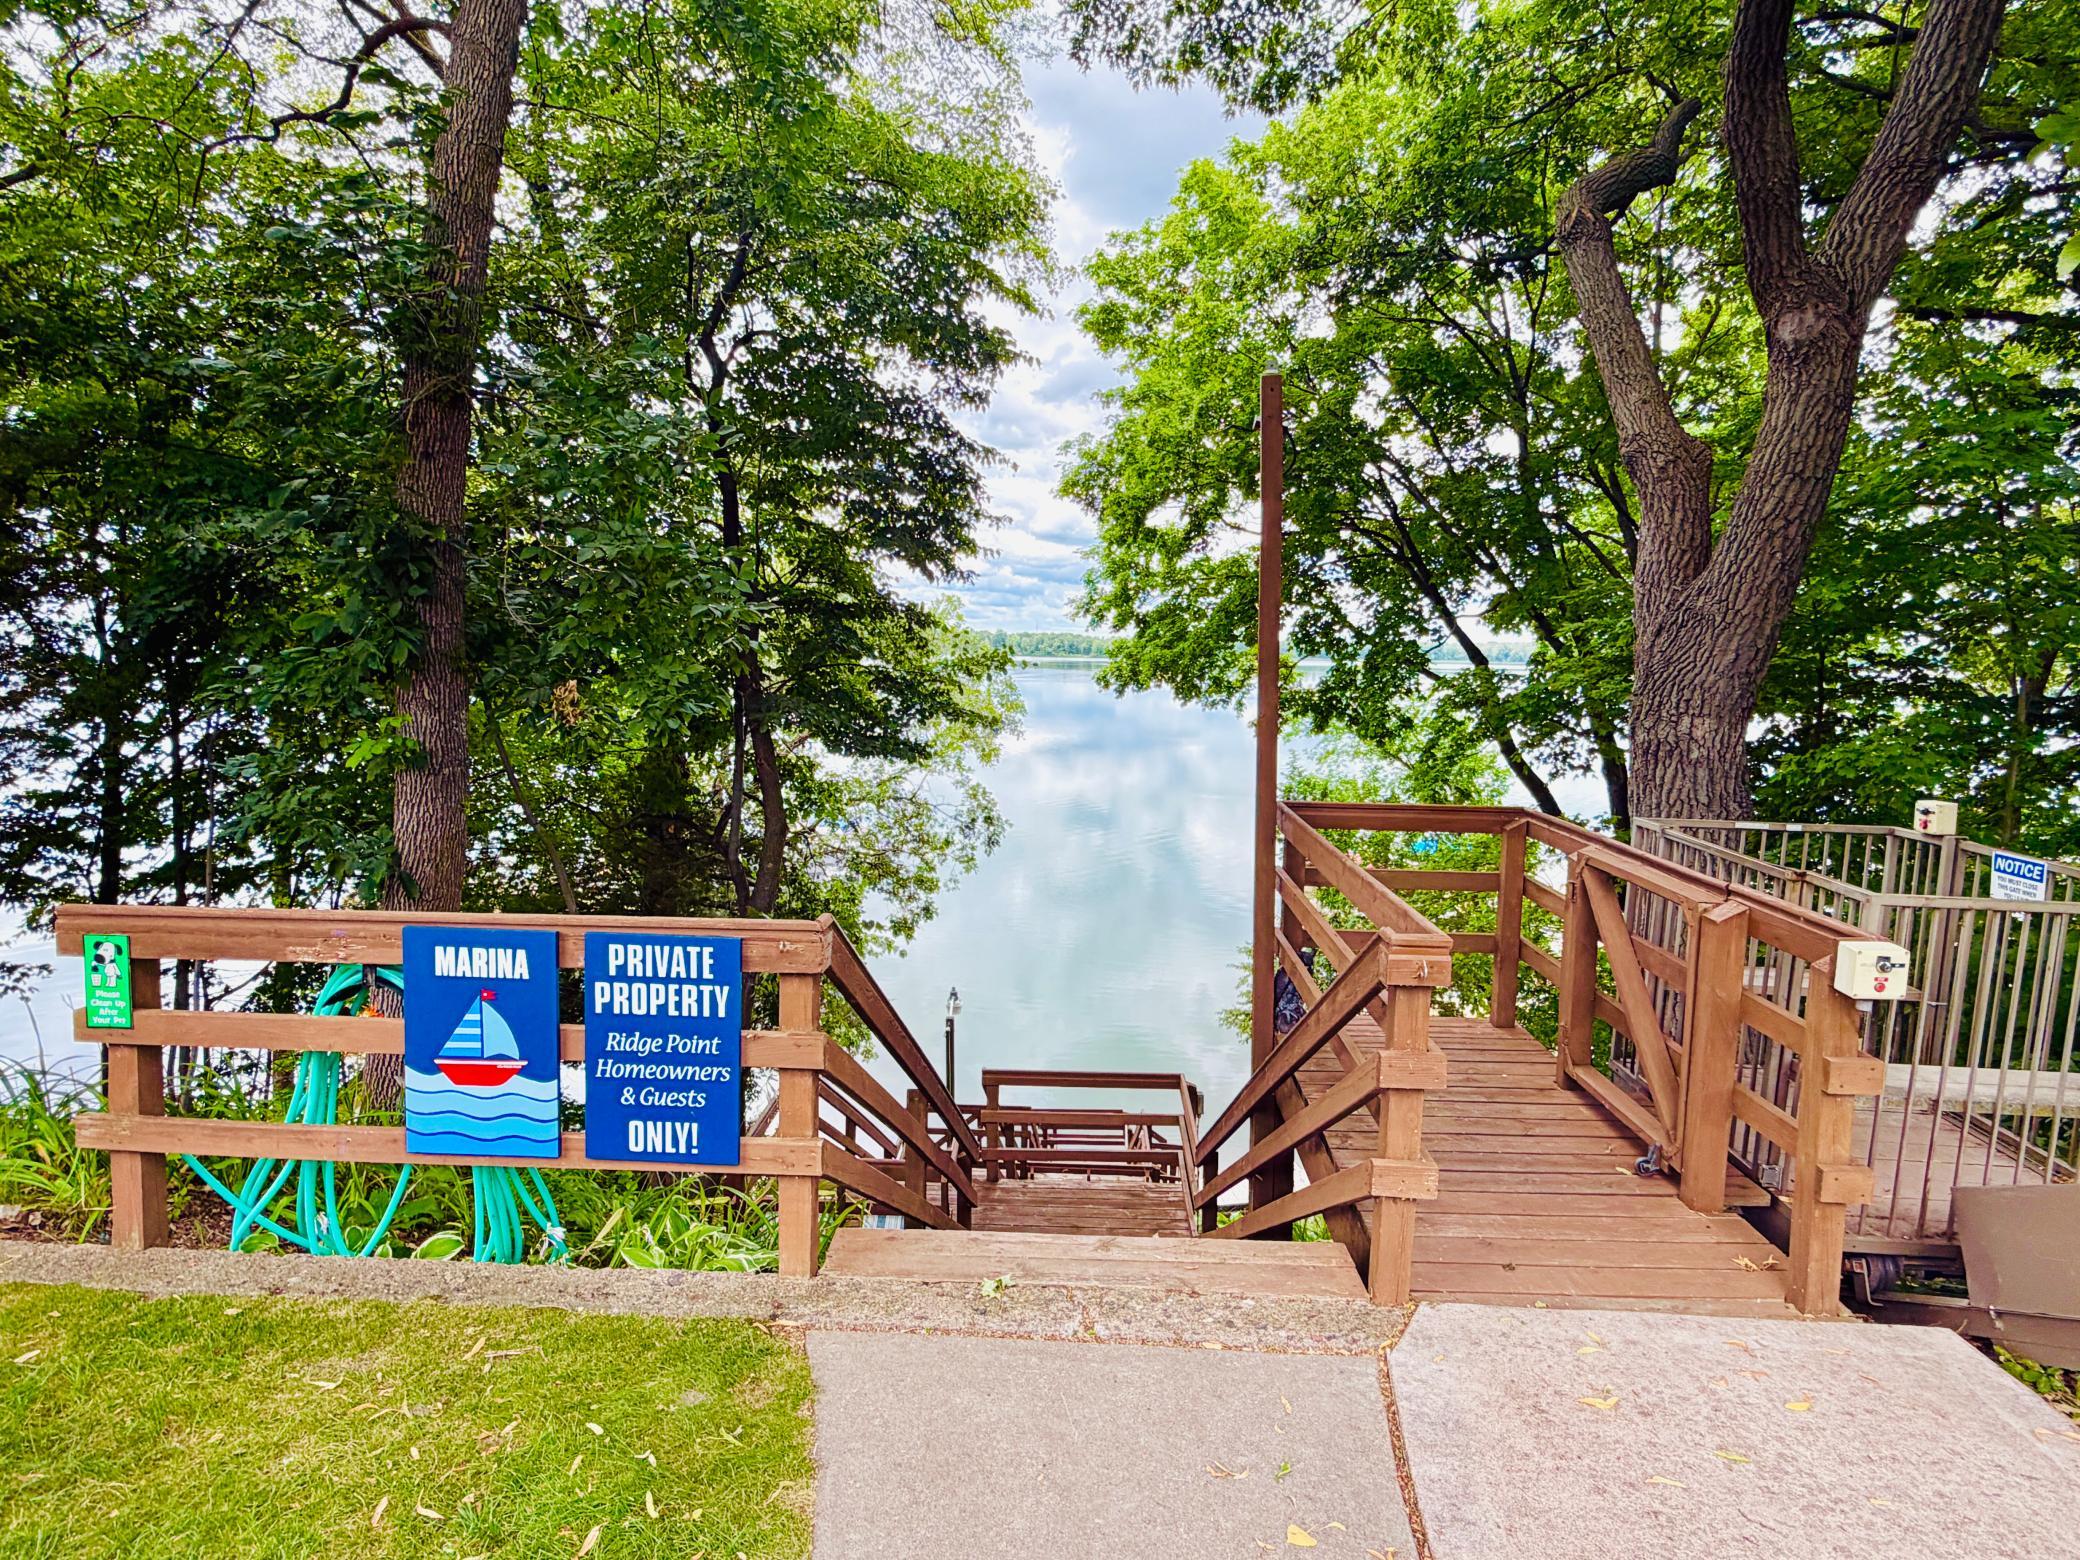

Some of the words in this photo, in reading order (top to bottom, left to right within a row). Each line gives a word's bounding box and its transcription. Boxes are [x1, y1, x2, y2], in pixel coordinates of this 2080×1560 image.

[1995, 857, 2043, 880] NOTICE
[2008, 878, 2021, 886] MUST
[2022, 881, 2038, 891] CLOSE
[2009, 886, 2021, 895] GATE
[434, 945, 530, 980] MARINA
[608, 943, 714, 980] PRIVATE
[91, 999, 112, 1007] Clean
[95, 990, 120, 998] Please
[594, 981, 730, 1018] PROPERTY
[92, 1016, 110, 1024] Your
[605, 1031, 663, 1057] Ridge
[665, 1034, 722, 1055] Point
[595, 1058, 731, 1082] Homeowners
[620, 1086, 636, 1105] &
[639, 1086, 706, 1108] Guests
[628, 1119, 699, 1155] ONLY!
